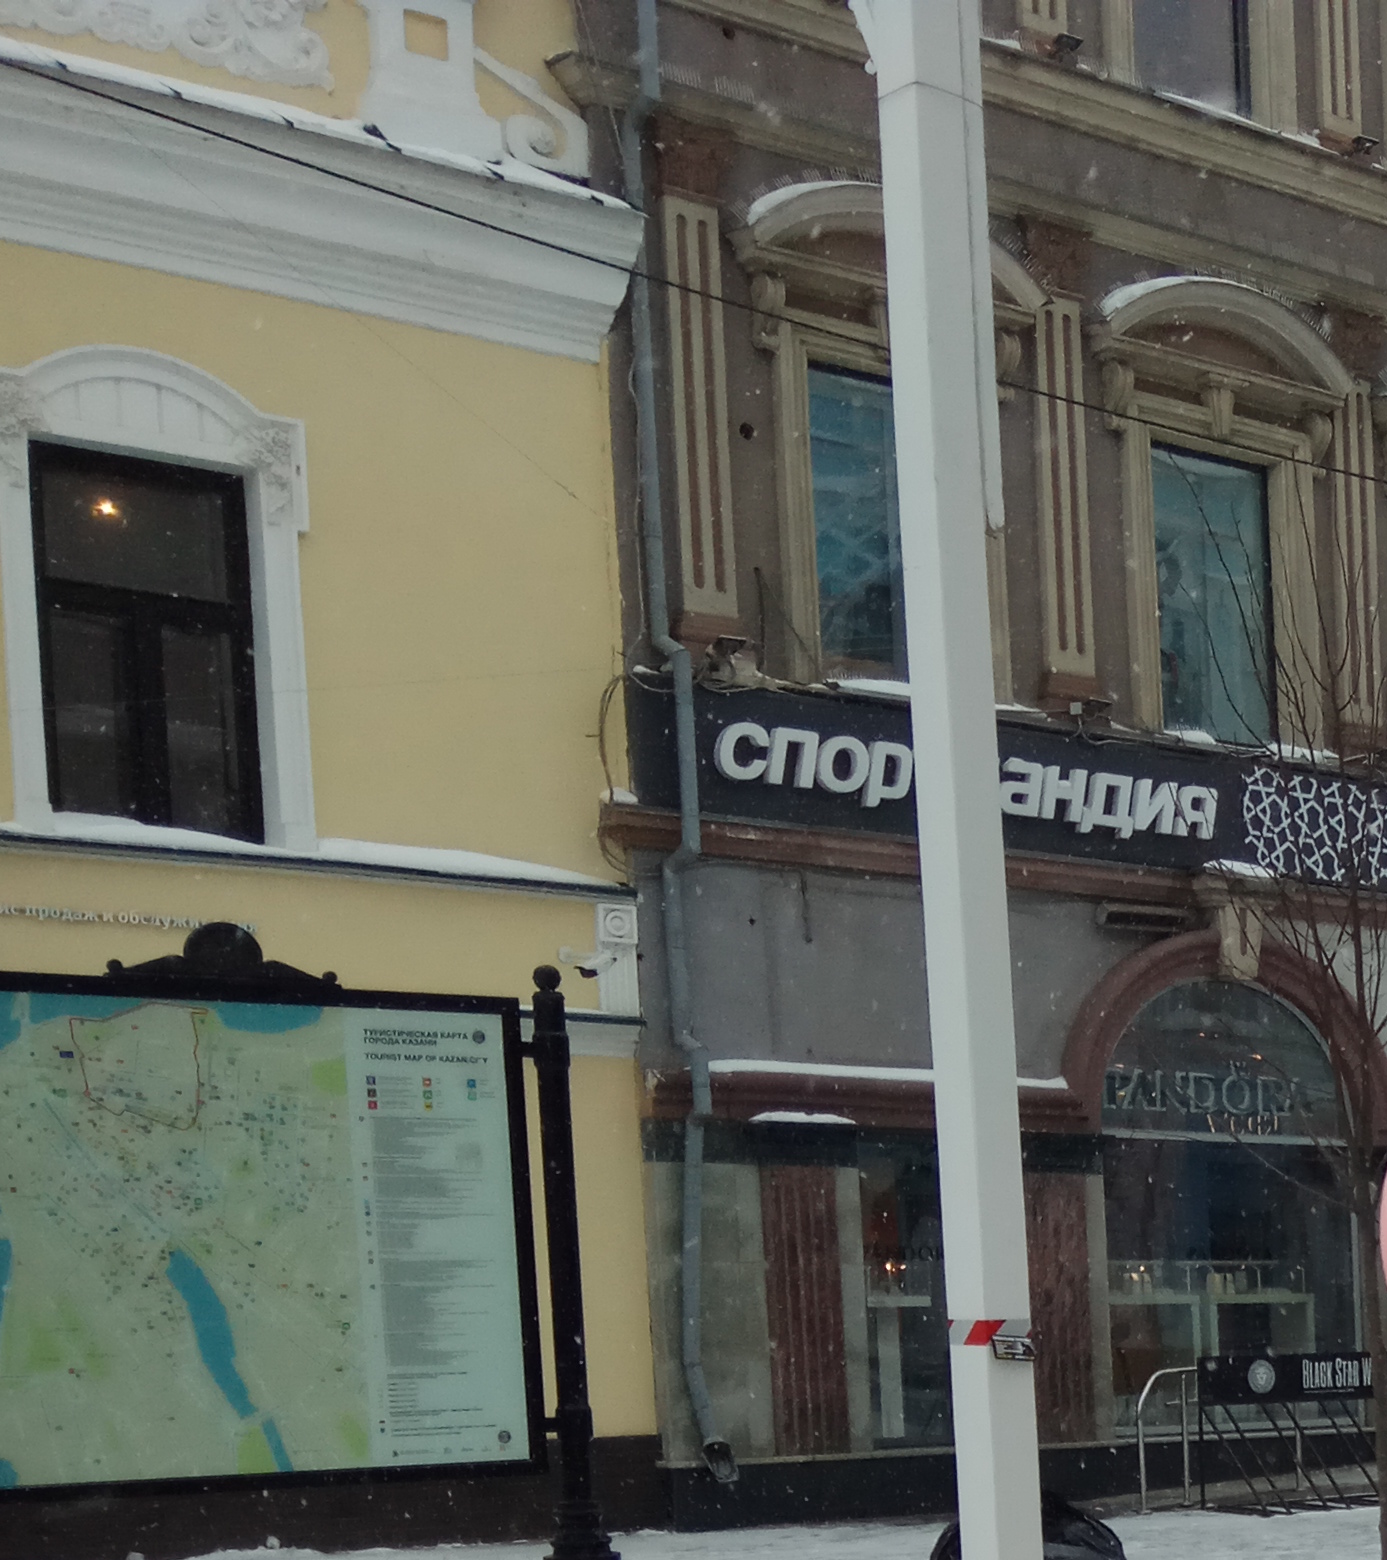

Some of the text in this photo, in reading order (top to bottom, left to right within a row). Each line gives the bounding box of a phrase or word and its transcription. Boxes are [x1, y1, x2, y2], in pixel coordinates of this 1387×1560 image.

[713, 721, 1218, 840] спорандия
[25, 905, 98, 922] продаж
[103, 912, 114, 922] и
[440, 1032, 468, 1040] КАРТА
[365, 1052, 401, 1061] TOURIST
[404, 1054, 422, 1062] MAP
